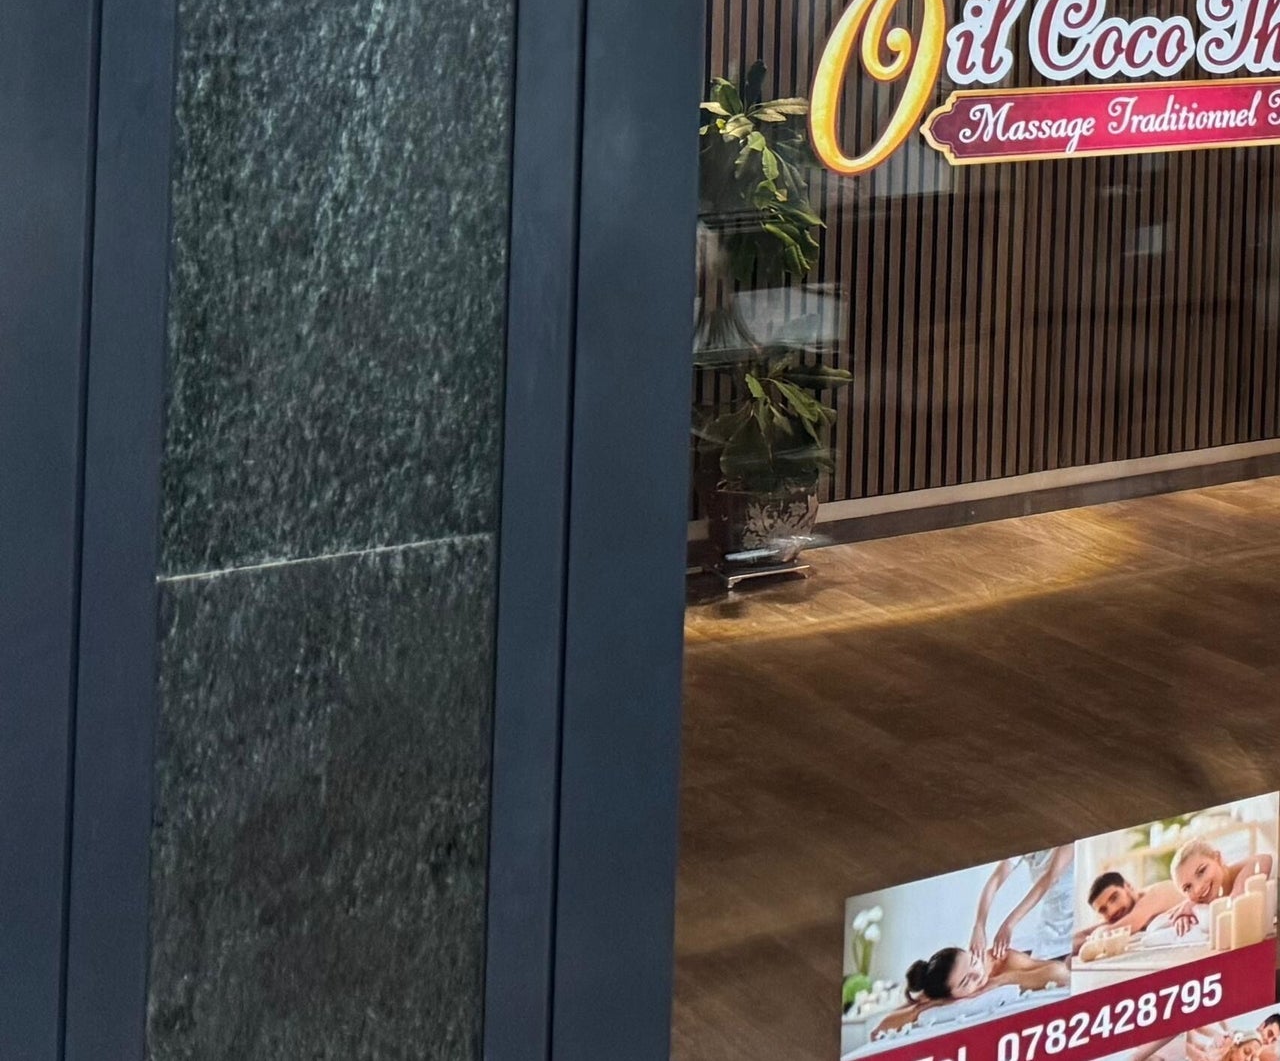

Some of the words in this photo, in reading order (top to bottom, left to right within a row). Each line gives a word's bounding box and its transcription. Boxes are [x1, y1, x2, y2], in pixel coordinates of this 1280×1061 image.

[958, 102, 1096, 154] Massage
[1106, 94, 1257, 134] Traditionnel
[998, 972, 1223, 1061] 0782428795
